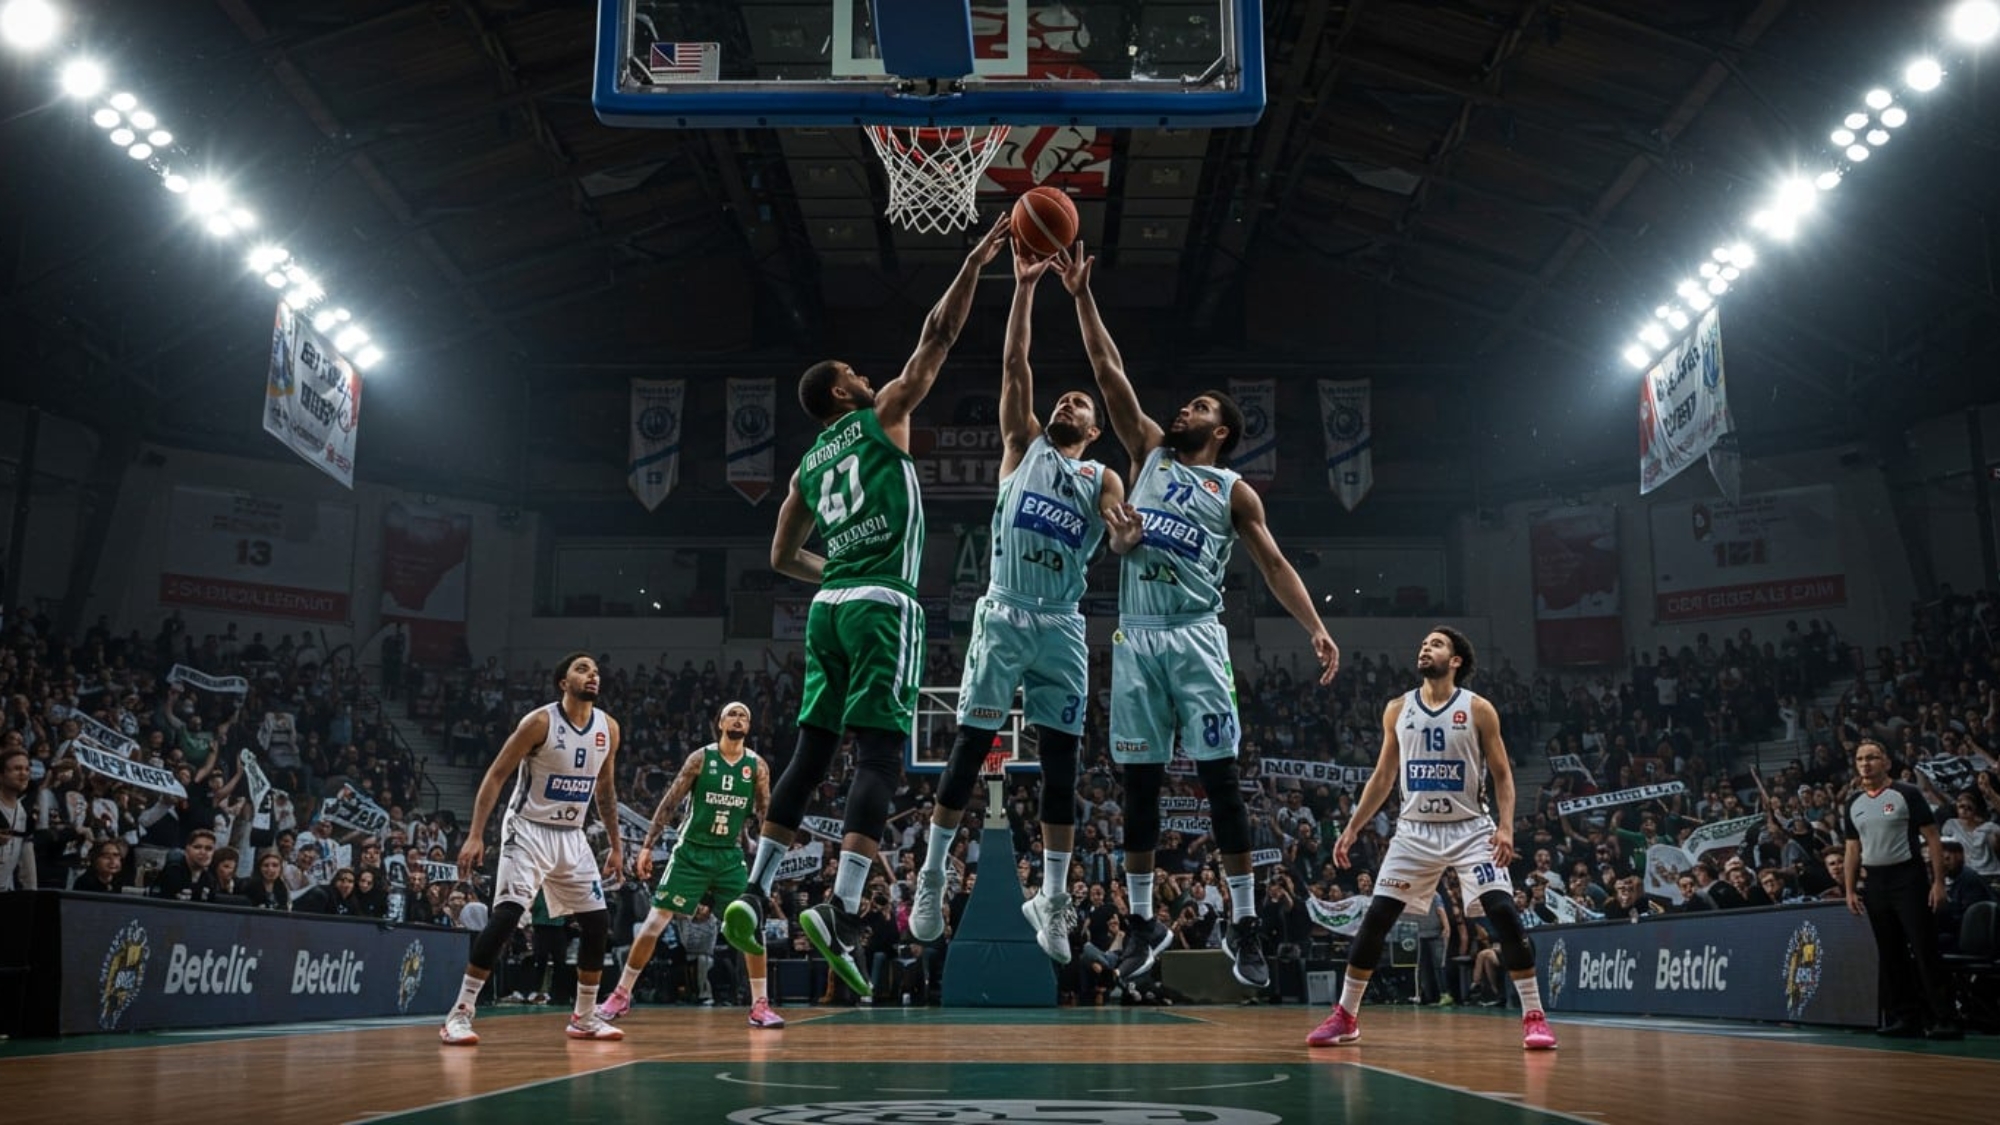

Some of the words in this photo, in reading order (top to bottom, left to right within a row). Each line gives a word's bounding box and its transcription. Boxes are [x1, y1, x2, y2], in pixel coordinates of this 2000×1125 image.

[163, 943, 257, 995] Betclic
[290, 949, 365, 995] Betclic
[1655, 944, 1729, 991] Betclic
